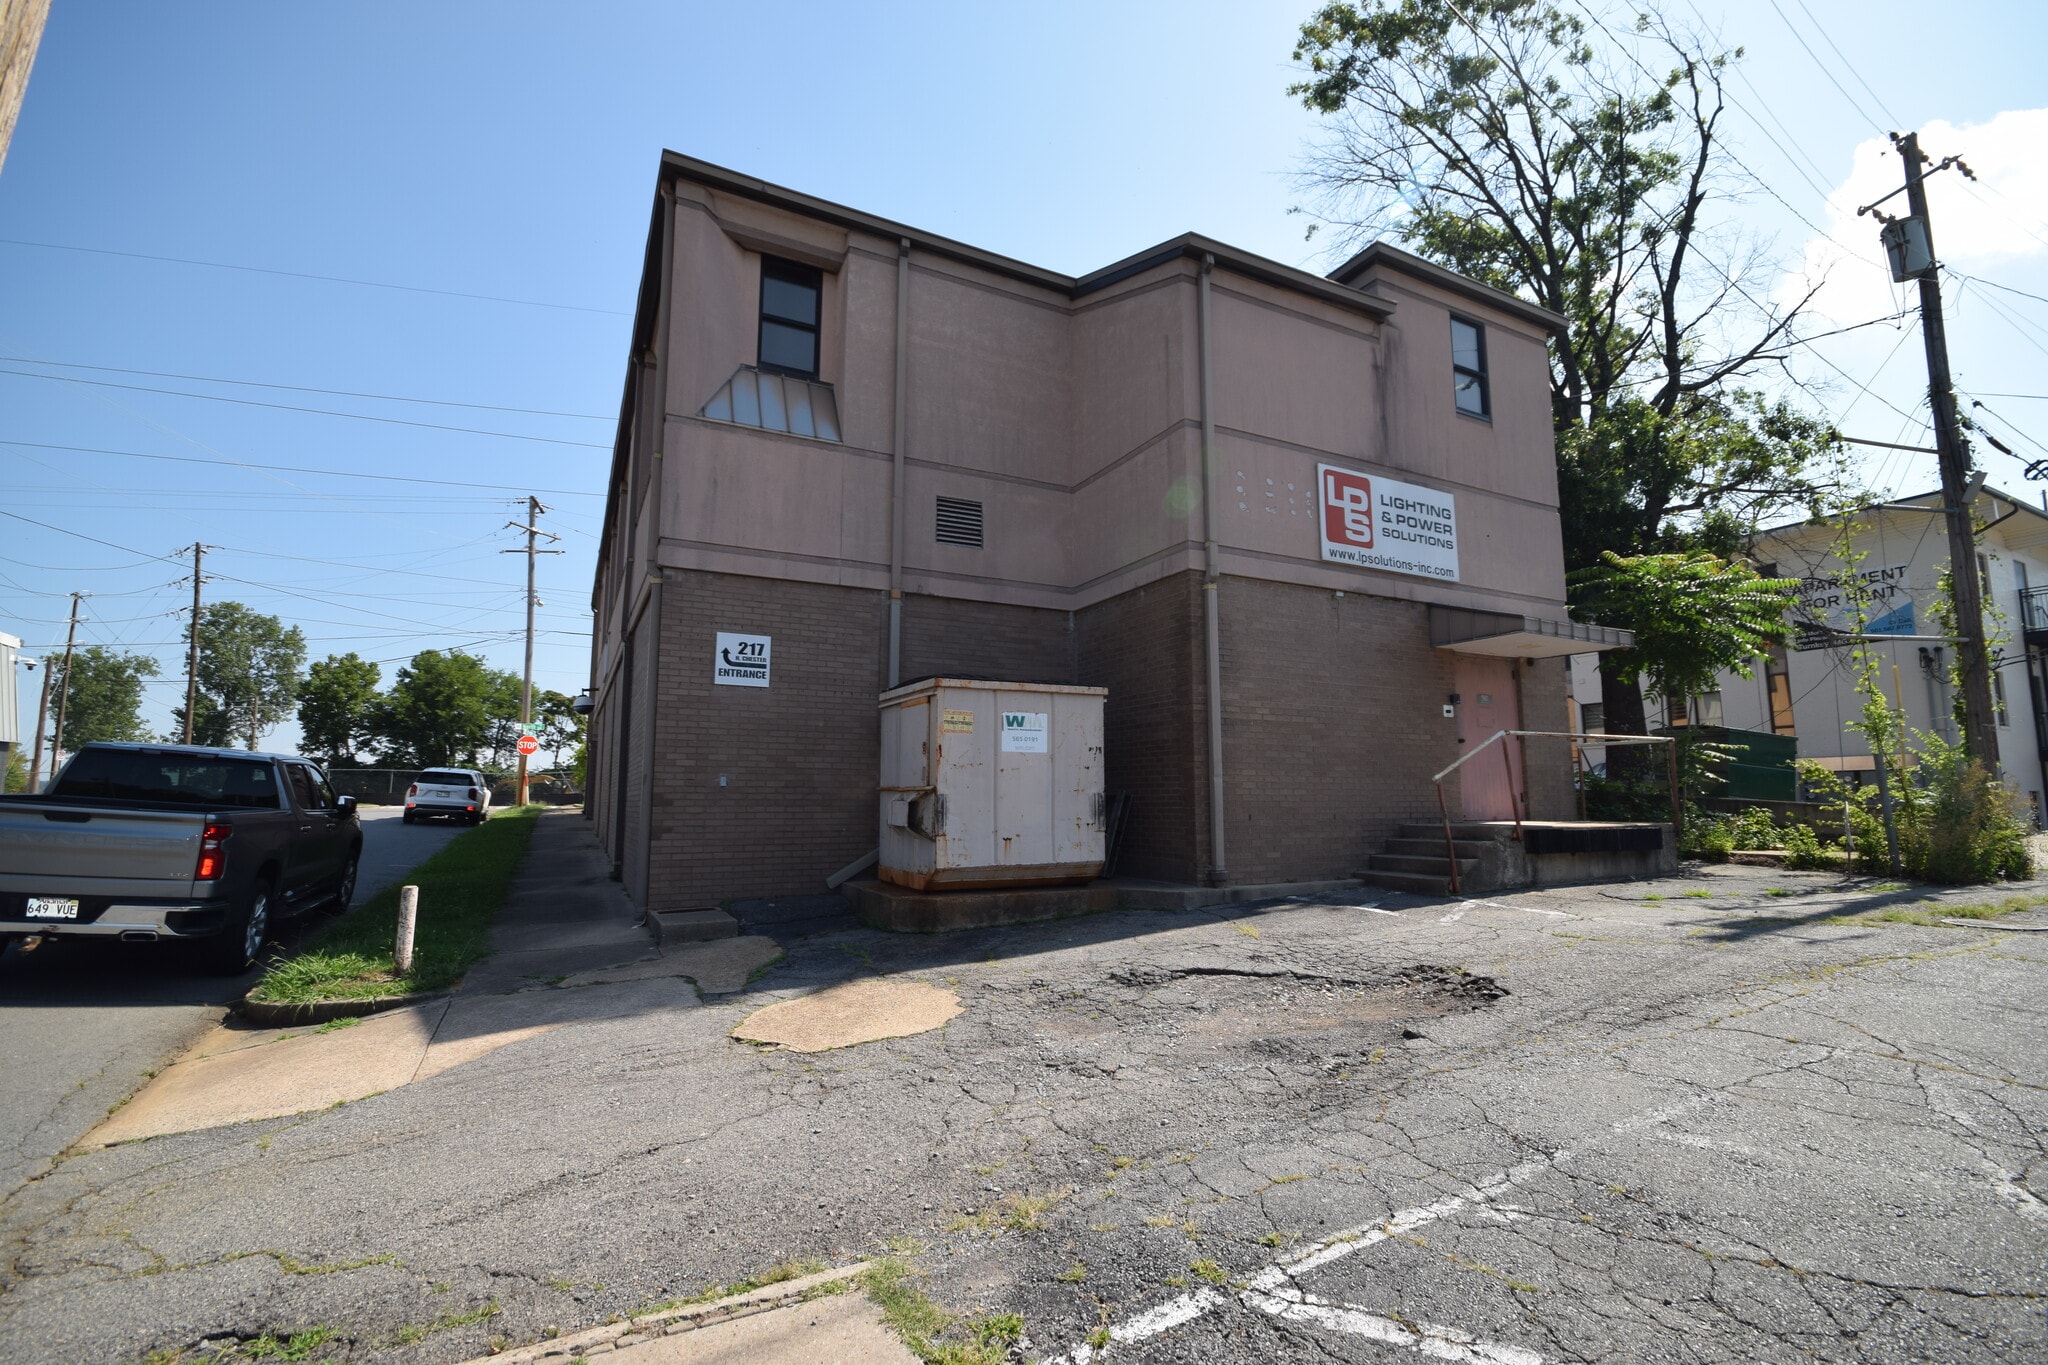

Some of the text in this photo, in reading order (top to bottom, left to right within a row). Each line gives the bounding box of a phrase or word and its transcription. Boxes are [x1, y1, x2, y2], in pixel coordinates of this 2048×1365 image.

[1326, 475, 1371, 543] LPS
[1380, 494, 1452, 520] LIGHTING
[1381, 511, 1453, 536] & POWER
[1382, 527, 1454, 549] SOLUTIONS
[1329, 548, 1455, 577] www.lpsolutions-inc.com
[1792, 566, 1907, 597] APARMENT
[738, 642, 765, 656] 217
[718, 668, 767, 680] ENTRANCE
[519, 741, 538, 749] STOP
[27, 904, 77, 915] 649 VUE
